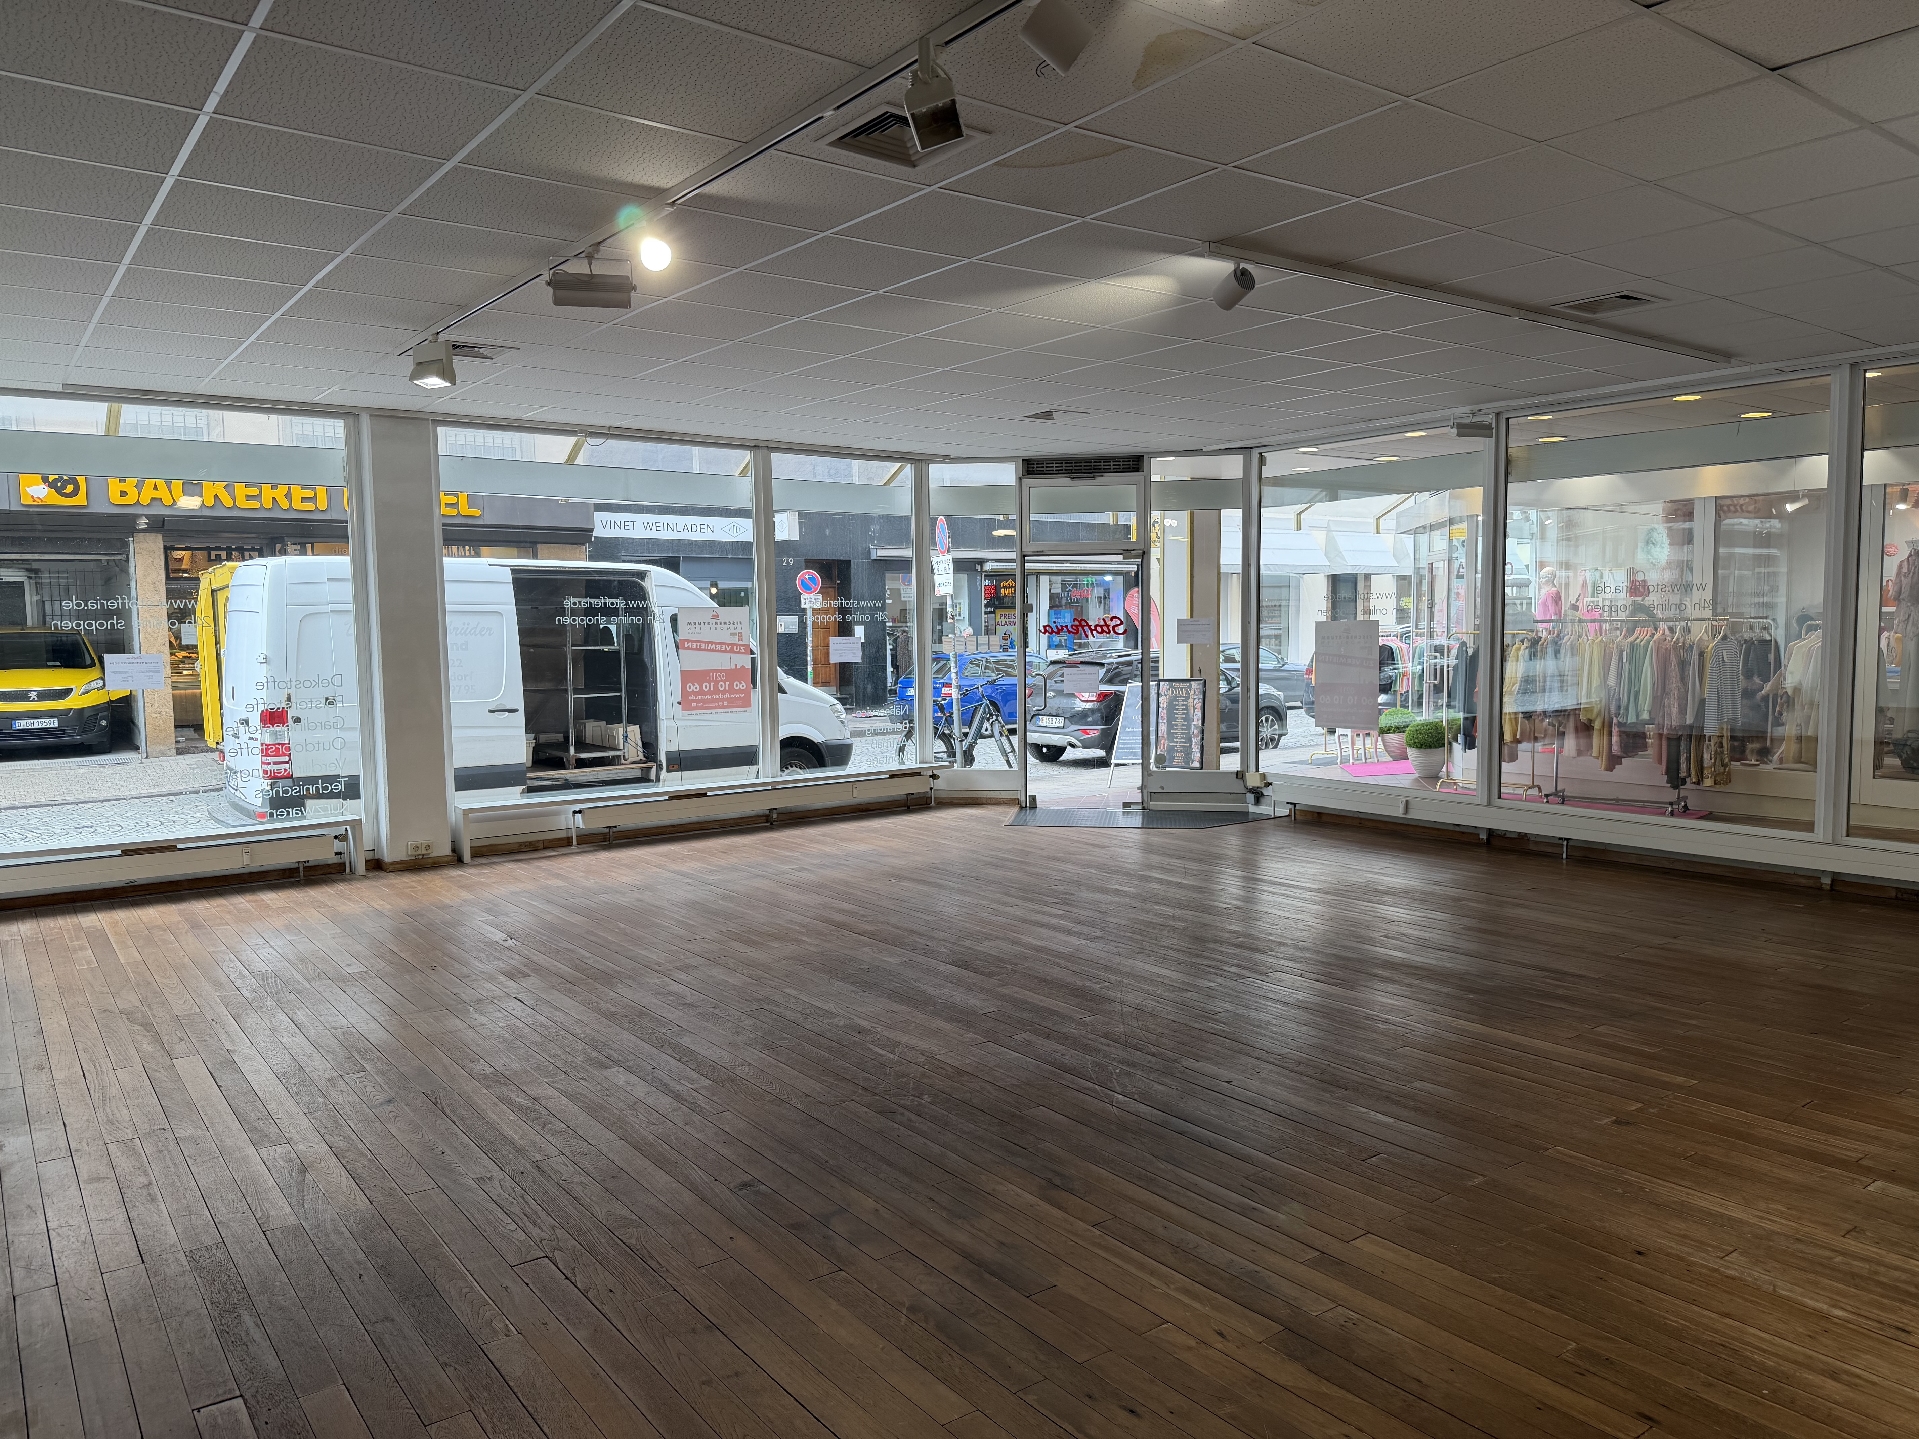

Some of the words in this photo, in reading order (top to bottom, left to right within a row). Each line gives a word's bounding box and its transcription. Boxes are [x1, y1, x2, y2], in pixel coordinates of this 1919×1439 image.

[600, 519, 636, 531] VINET
[642, 521, 715, 534] WEINLADEN
[782, 558, 794, 566] 29
